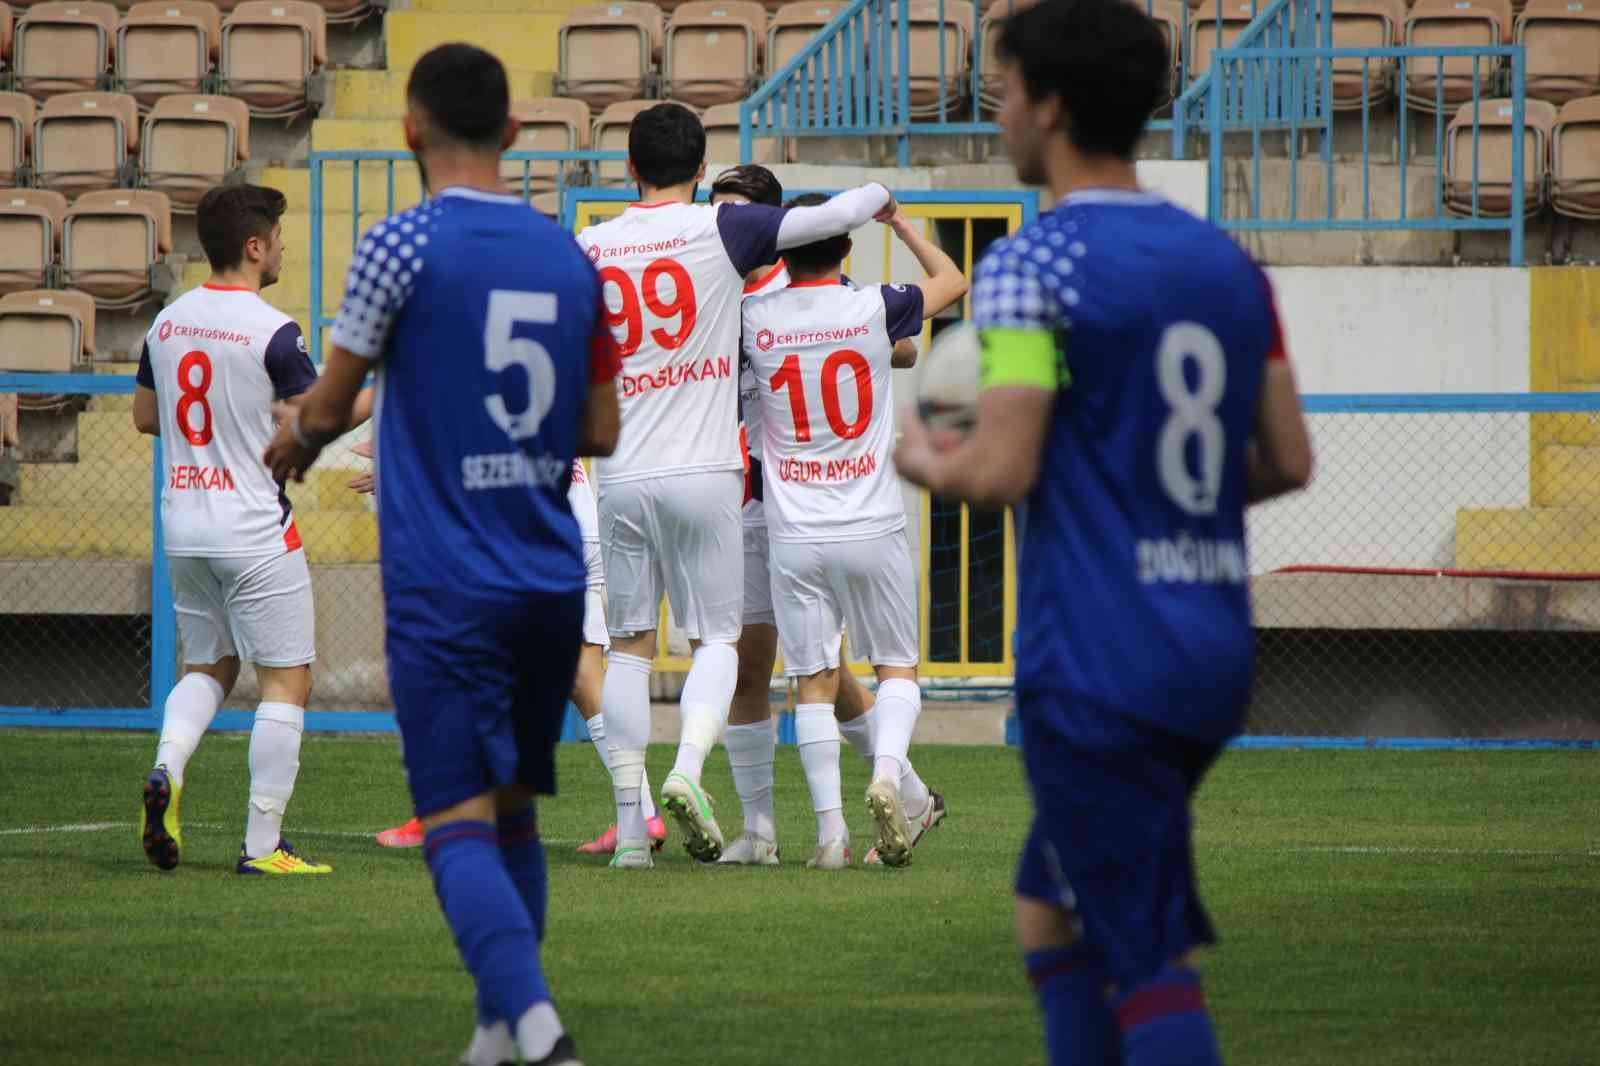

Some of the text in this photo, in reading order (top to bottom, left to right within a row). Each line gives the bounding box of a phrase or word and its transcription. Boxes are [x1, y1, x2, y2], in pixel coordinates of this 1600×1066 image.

[603, 236, 688, 258] CRIPTOSWAPS
[174, 326, 251, 346] CRIPTOSWAPS
[598, 257, 697, 357] 99
[777, 324, 870, 344] CRIPTOSWAPS
[176, 350, 214, 446] 8
[484, 289, 558, 441] 5
[769, 349, 873, 443] 10
[1156, 321, 1227, 516] 8
